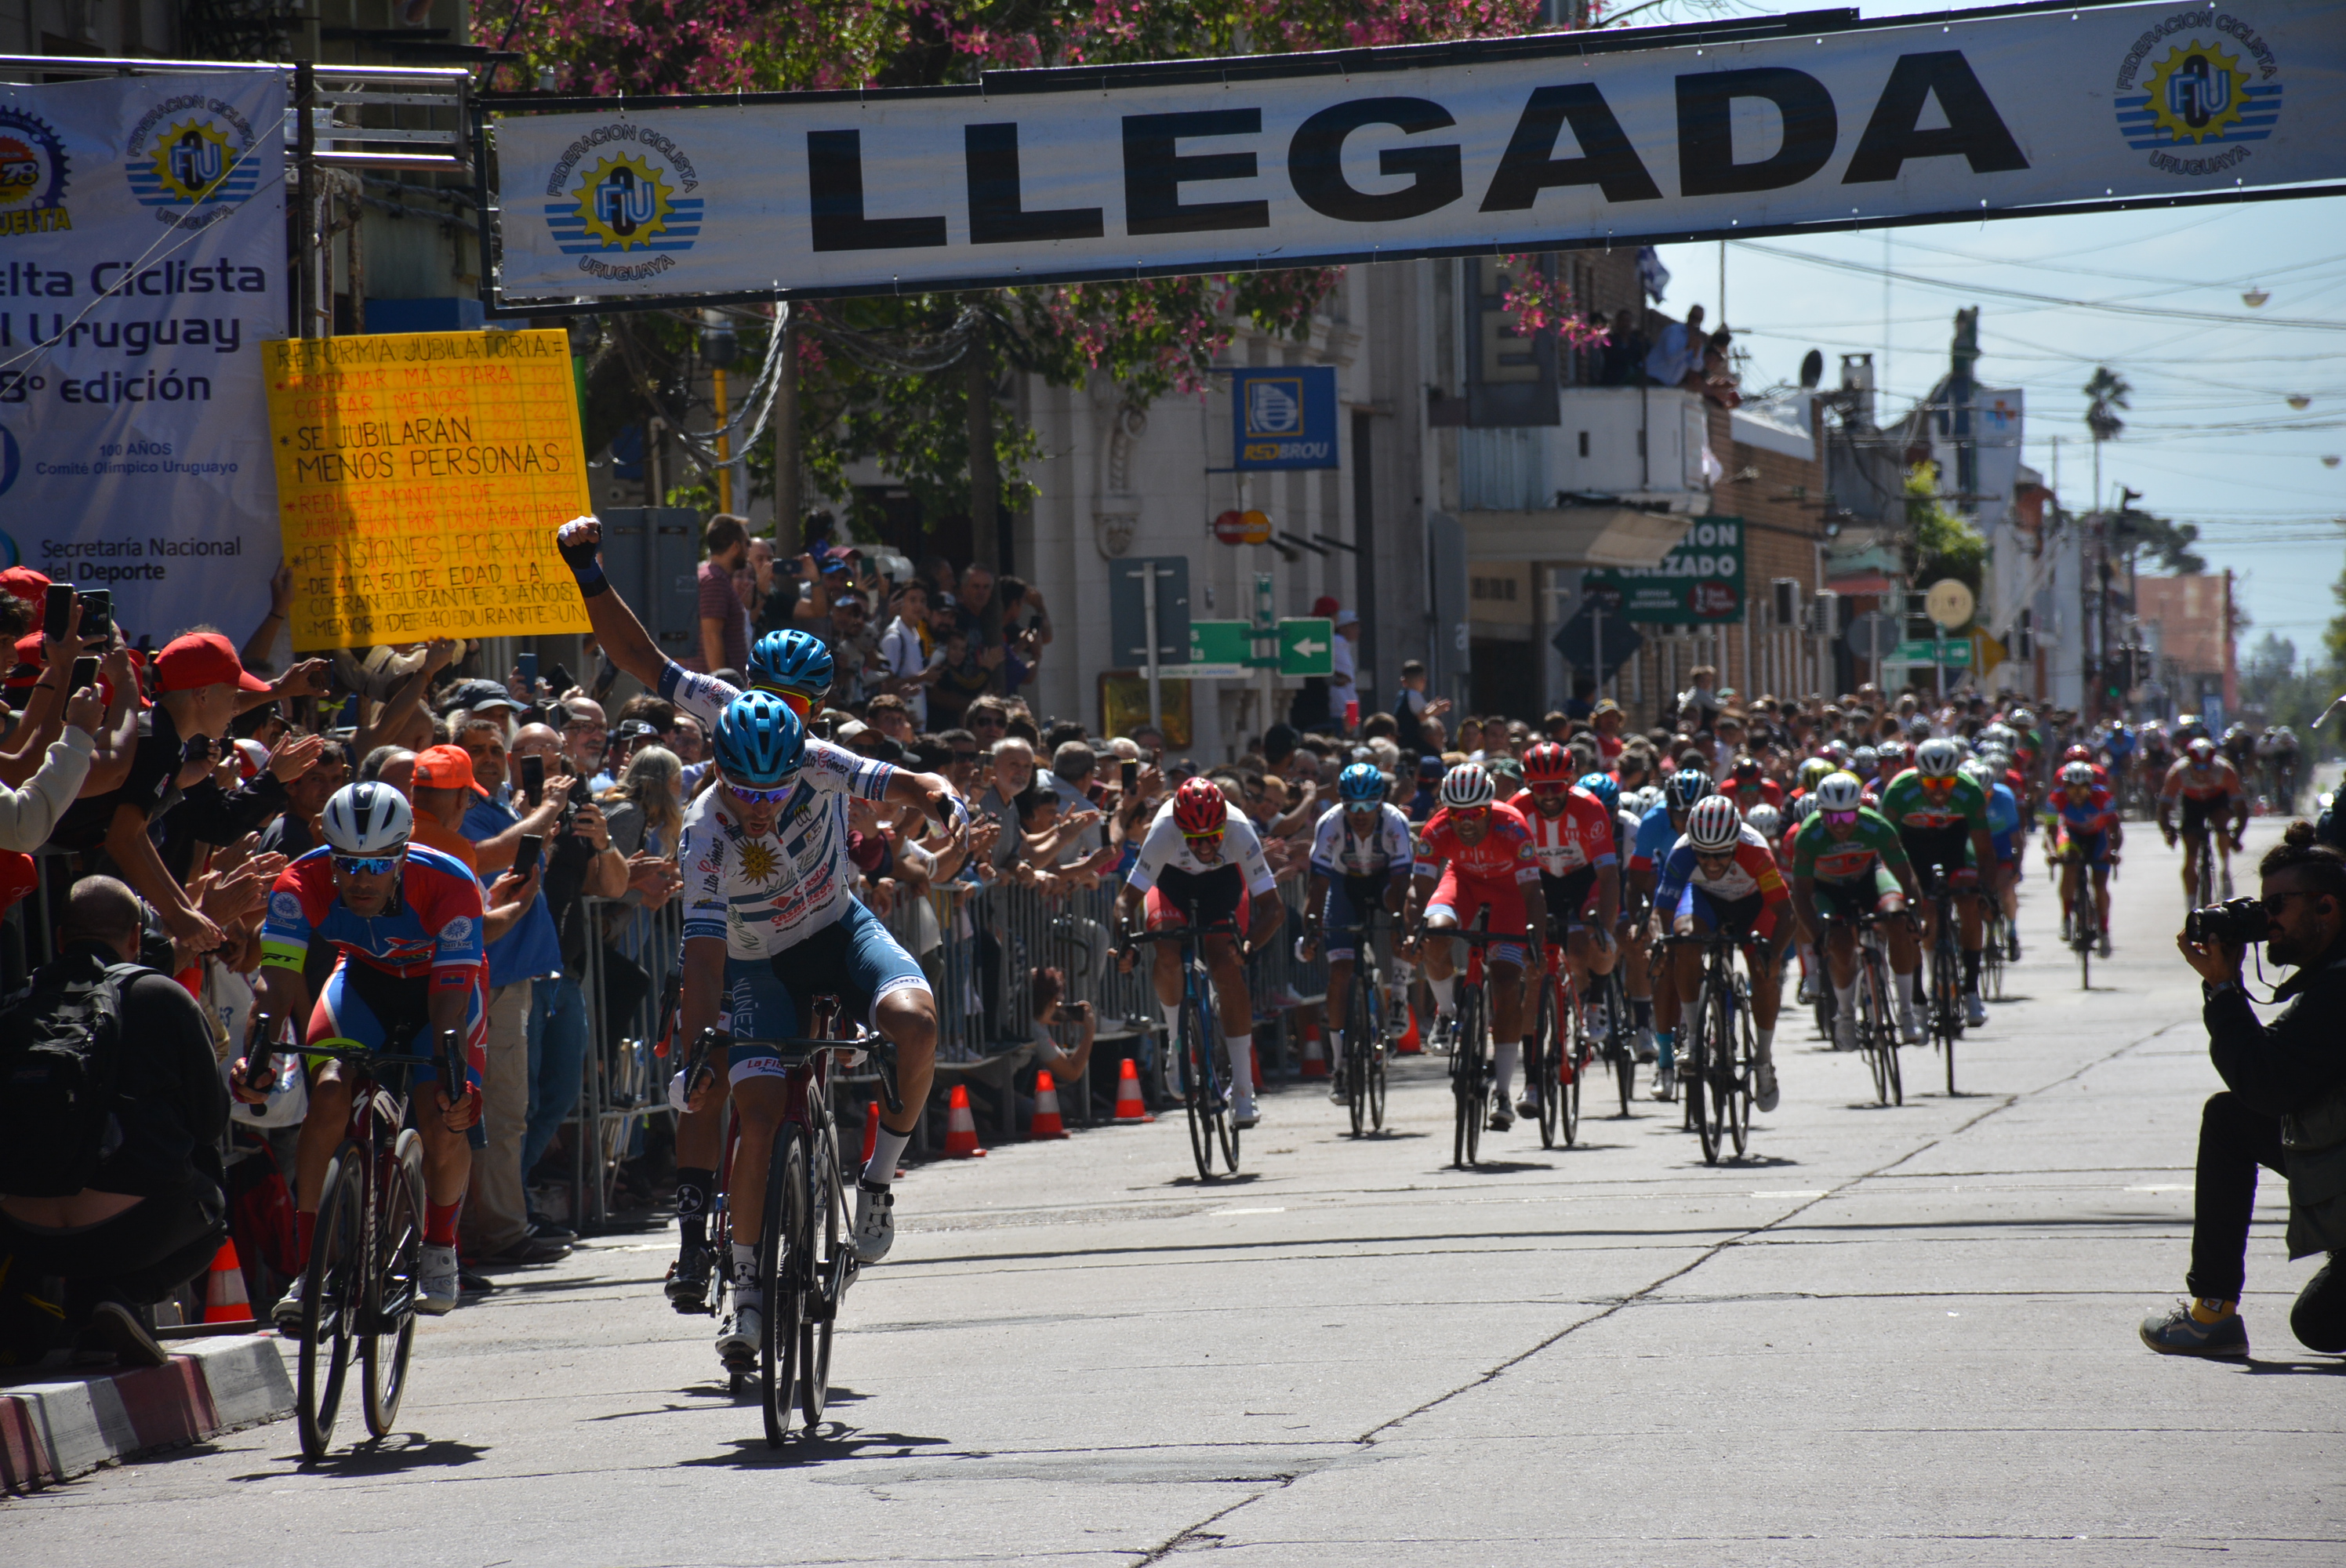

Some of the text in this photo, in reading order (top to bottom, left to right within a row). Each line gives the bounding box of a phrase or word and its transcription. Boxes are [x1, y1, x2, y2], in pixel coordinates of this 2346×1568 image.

[2116, 11, 2277, 90] FEDERACION CICLISTA
[127, 94, 258, 157] FEDERACION CICLISTA
[547, 124, 699, 197] FEDERACION CICLISTA
[807, 49, 2031, 252] LLEGADA
[2148, 144, 2251, 175] URUGUAYA
[0, 206, 71, 235] UELTA
[155, 204, 234, 230] URUGUAYA
[0, 257, 265, 296] lta Ciclista
[579, 254, 675, 281] URUGUAYA
[30, 313, 240, 356] Uruguay
[277, 337, 397, 368] REFORMA
[60, 368, 211, 404] edición
[290, 363, 513, 394] TRABAJAR MÁS PARA
[295, 389, 468, 419] COBRAR MENOS
[100, 440, 172, 456] 100 AÑOS
[298, 426, 325, 452] SE
[36, 461, 89, 475] Comité
[163, 460, 238, 475] Uruguayo
[297, 443, 561, 483] MENOS PERSONAS
[300, 484, 499, 514] REDUCE MONTOS DE
[300, 502, 578, 539] JUBILACIÓN POR DISCAPACIDAD
[42, 536, 241, 557] Secretaría Nacional
[303, 528, 560, 572] PENSIONES POR VIUD
[42, 562, 165, 584] del Deporte
[363, 573, 376, 591] A
[382, 572, 403, 589] 50
[412, 569, 437, 587] DE
[450, 564, 502, 584] EDAD
[514, 562, 543, 583] LA
[310, 581, 573, 618] COBRAN DURANTE 3 AÑOS
[389, 613, 419, 633] DE
[429, 609, 451, 630] 40
[460, 606, 547, 628] DURANTE
[559, 604, 586, 622] UN
[817, 747, 849, 775] Gómez
[697, 837, 724, 895] Lito Gómez
[794, 862, 829, 896] Castro
[746, 1059, 762, 1069] La
